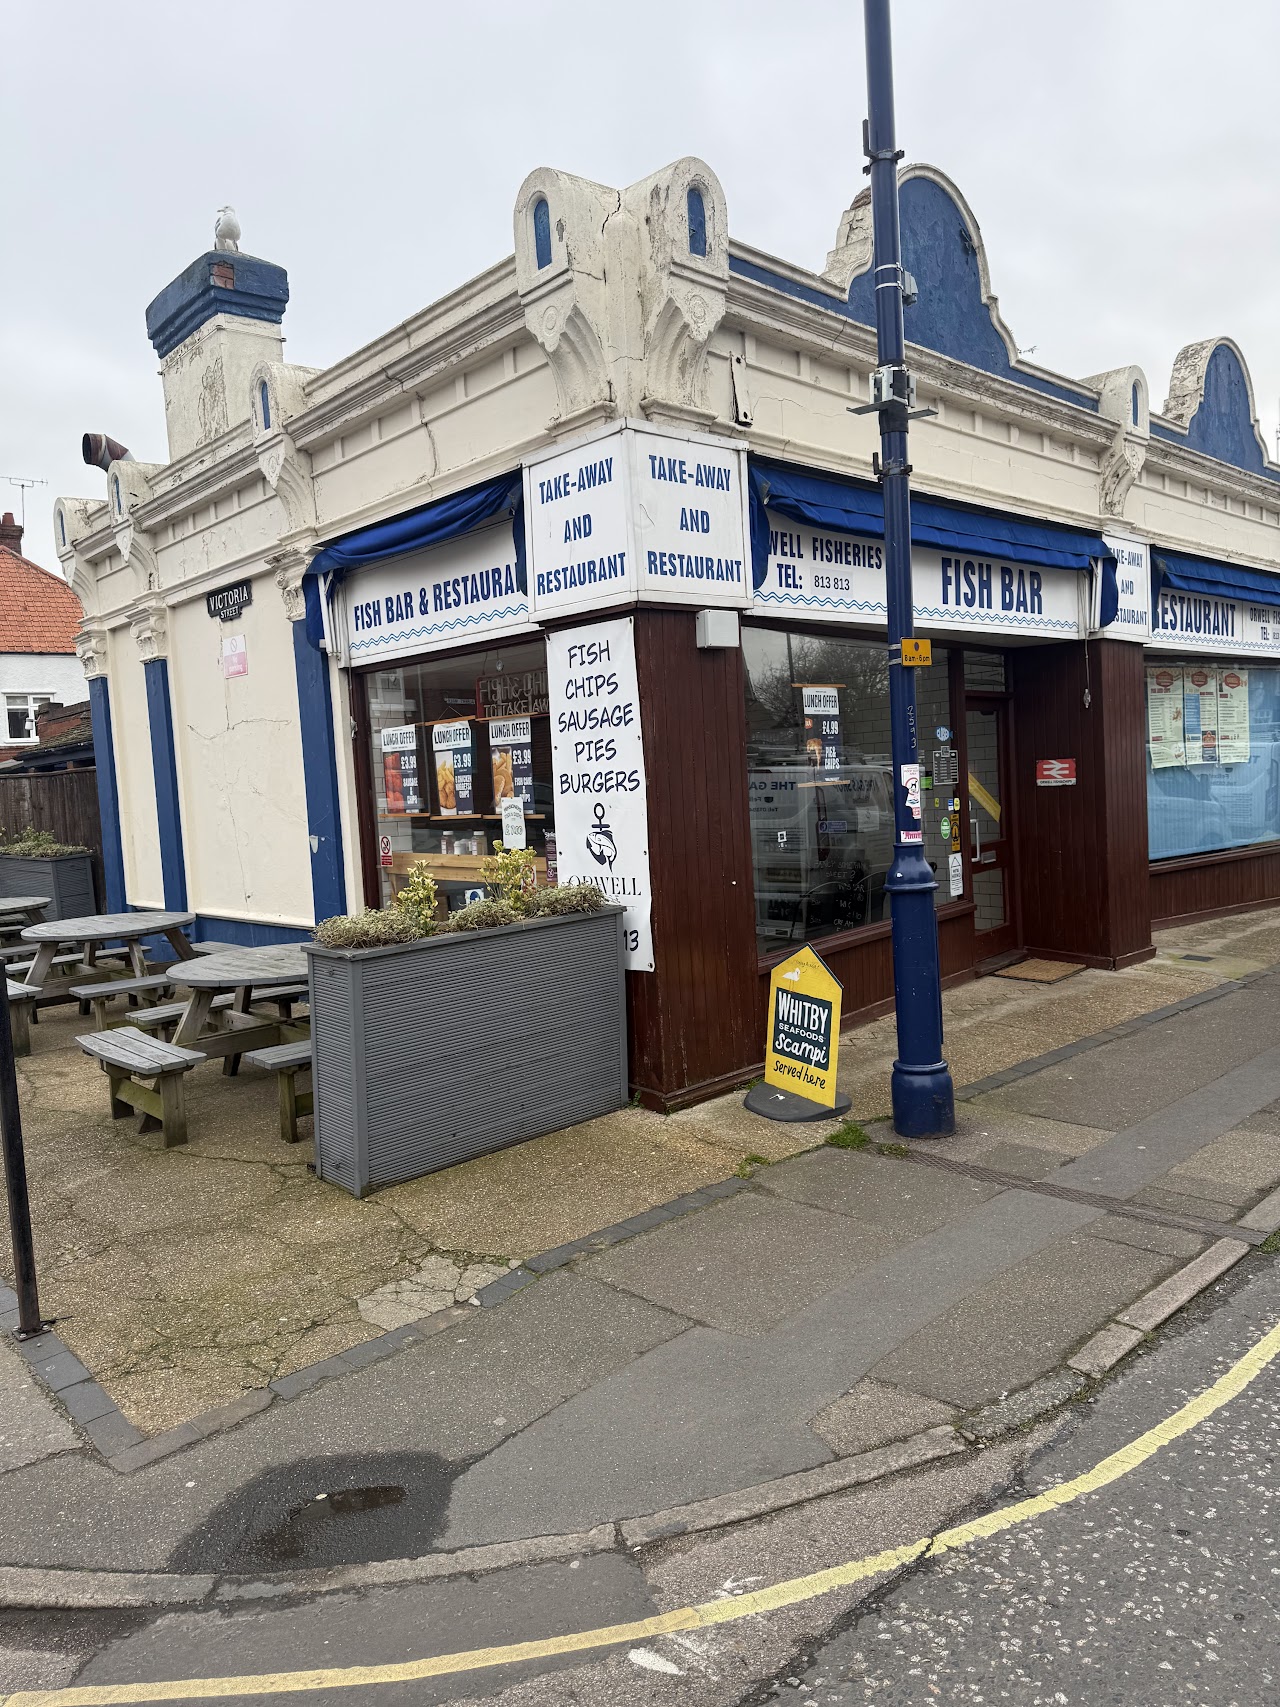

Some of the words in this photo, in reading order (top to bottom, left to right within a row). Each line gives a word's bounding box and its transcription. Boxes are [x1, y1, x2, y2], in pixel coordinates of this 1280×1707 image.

[539, 457, 613, 504] TAKE-AWAY
[649, 455, 731, 492] TAKE-AWAY
[563, 513, 592, 543] AND
[679, 507, 710, 534] AND
[812, 536, 882, 570] FISHERIES
[537, 552, 626, 595] RESTAURANT
[647, 550, 741, 582] RESTAURANT
[777, 563, 802, 590] TEL:
[814, 575, 831, 589] 813
[833, 577, 850, 591] 813
[209, 585, 248, 611] VICTORIA
[941, 556, 993, 609] FISH
[1001, 566, 1043, 615] BAR
[1120, 579, 1134, 595] AND
[220, 606, 239, 619] STREET
[354, 600, 382, 631] FISH
[385, 592, 414, 624] BAR
[419, 587, 429, 615] &
[1157, 593, 1236, 638] ESTAURANT
[1250, 607, 1270, 623] ORWELL
[568, 639, 611, 668] FISH
[565, 672, 619, 699] CHIPS
[804, 694, 821, 708] LUNCH
[823, 695, 838, 708] OFFER
[491, 723, 510, 739] LUNCH
[511, 721, 529, 737] OFFER
[558, 702, 634, 733] SAUSAGE
[822, 721, 838, 734] £4.99
[383, 732, 399, 746] LUNCH
[399, 731, 414, 745] OFFER
[434, 730, 452, 744] LUNCH
[453, 728, 470, 742] OFFER
[401, 755, 417, 769] £3.99
[454, 753, 471, 768] £3.99
[513, 749, 531, 765] £3.99
[574, 738, 617, 763] PIES
[825, 758, 840, 770] CHIPS
[559, 770, 640, 794] BURGERS
[778, 990, 828, 1034] WHITBY
[778, 1022, 825, 1043] SEAFOODS
[803, 1066, 826, 1089] here
